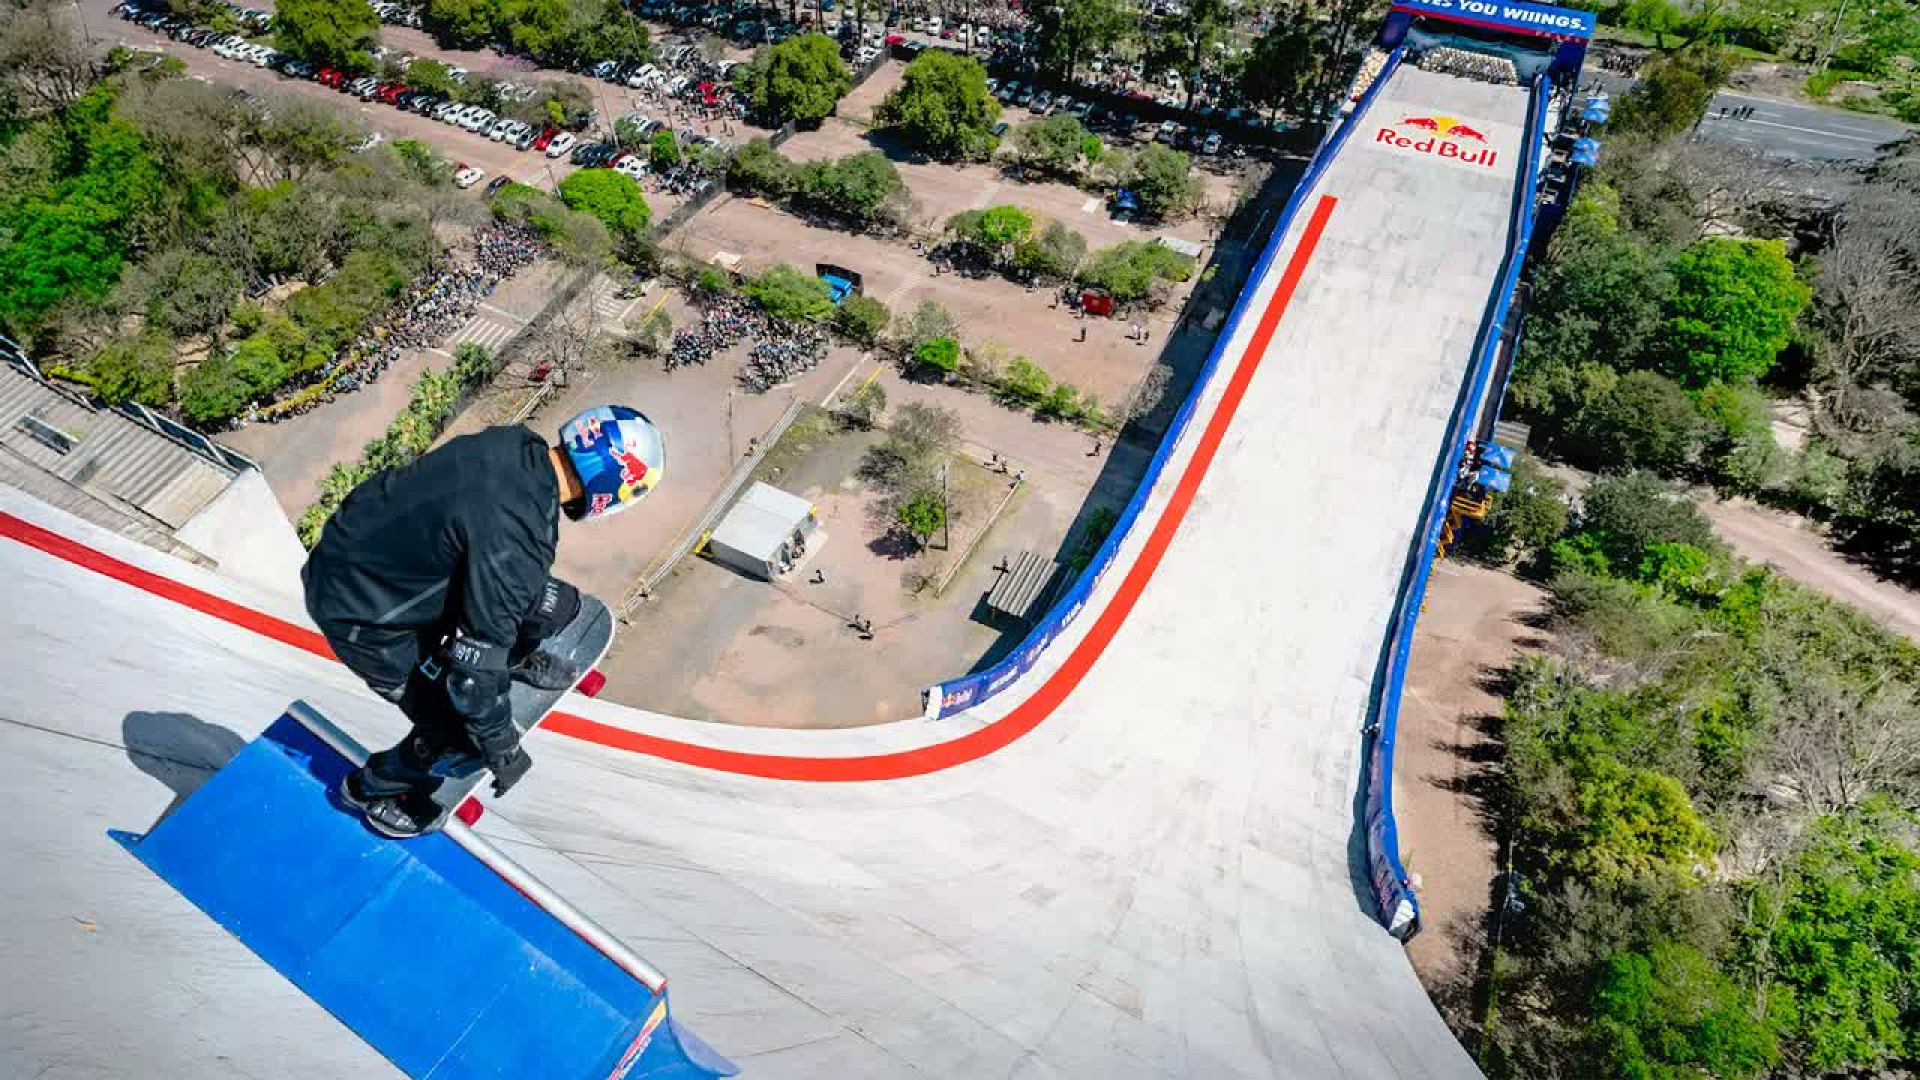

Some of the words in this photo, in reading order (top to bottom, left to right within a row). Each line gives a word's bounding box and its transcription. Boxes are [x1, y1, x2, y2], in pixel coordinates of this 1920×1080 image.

[1459, 0, 1498, 16] YOU
[1503, 7, 1588, 31] WIIINGS.
[1376, 128, 1436, 153] Red
[1437, 141, 1498, 167] Bull
